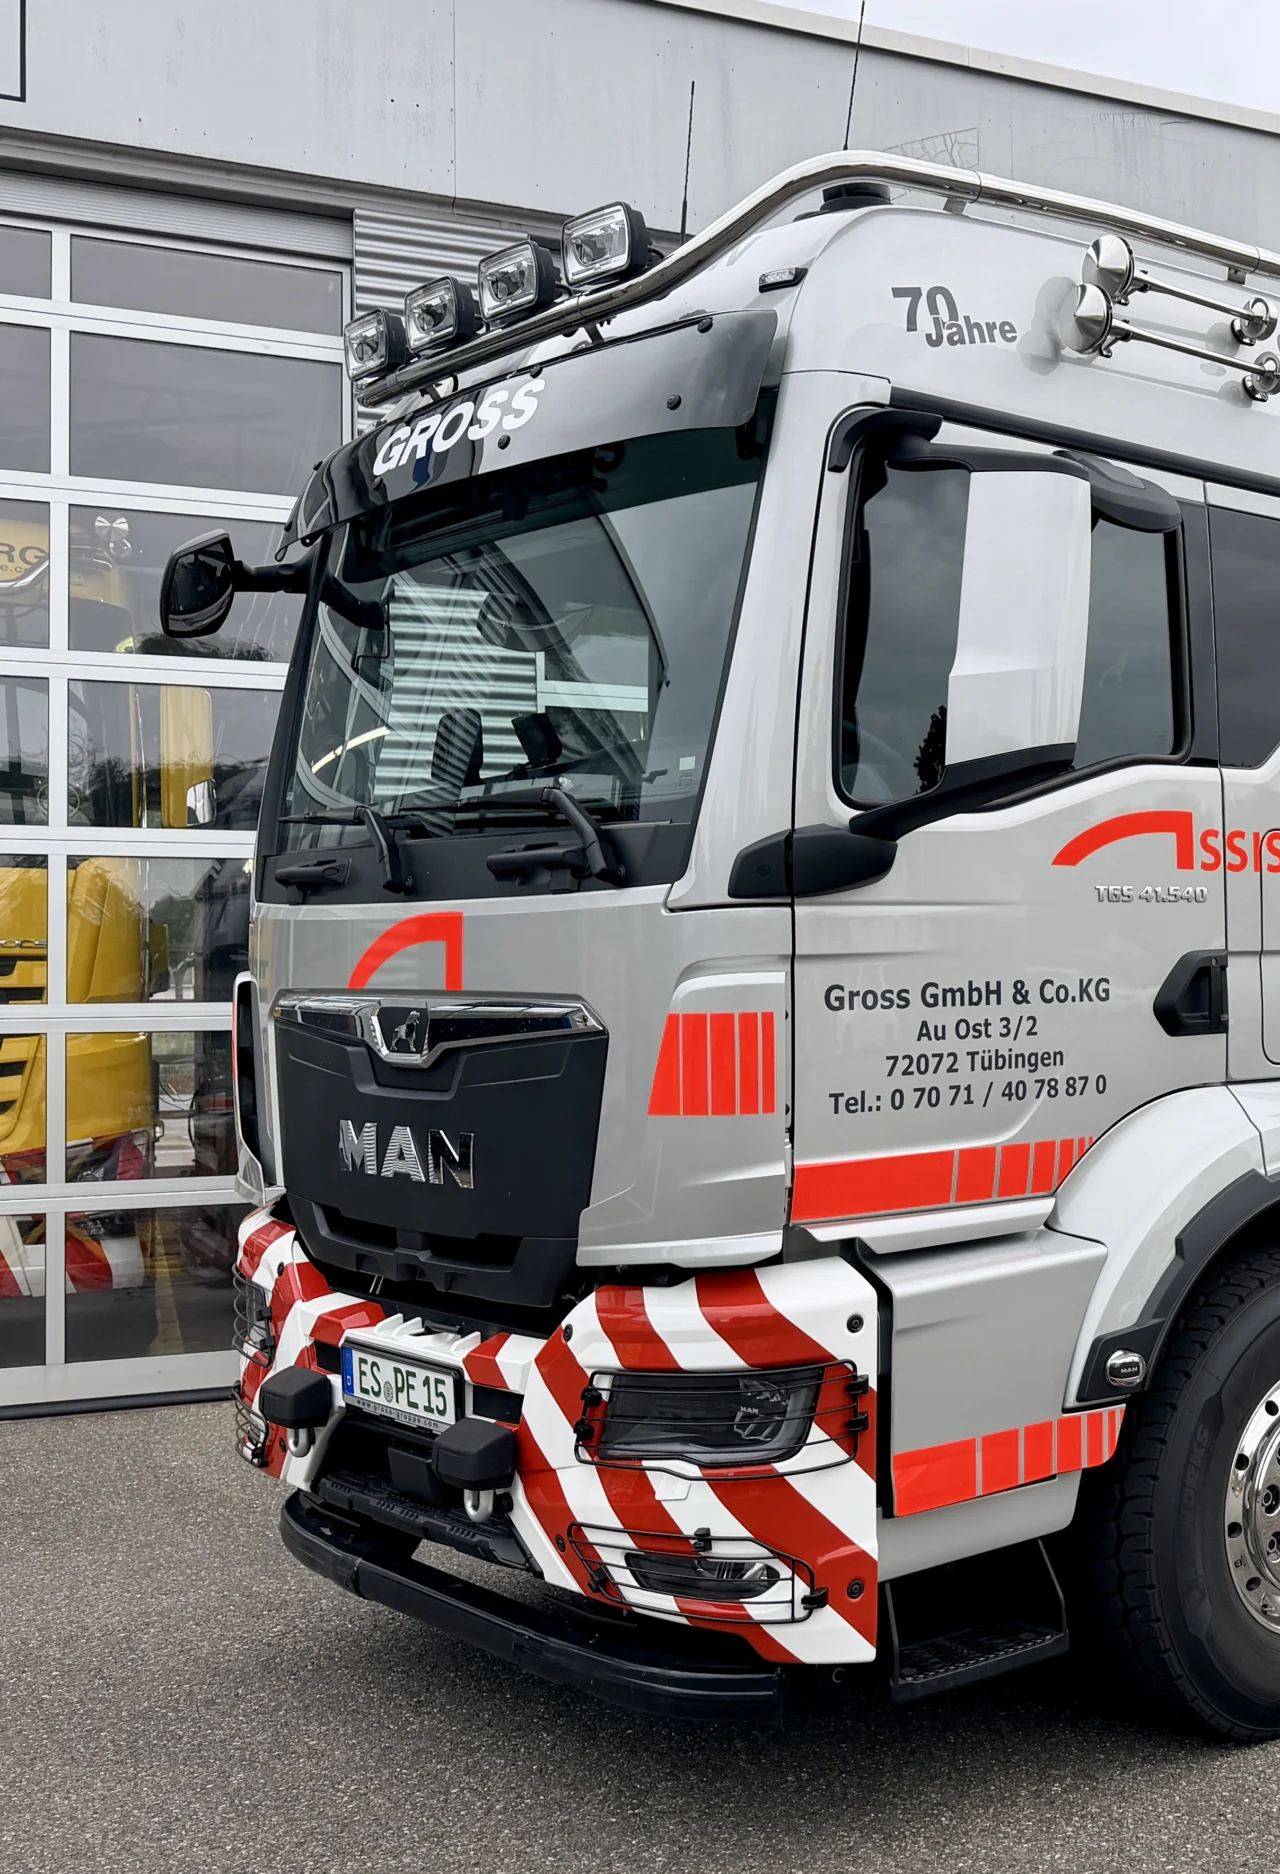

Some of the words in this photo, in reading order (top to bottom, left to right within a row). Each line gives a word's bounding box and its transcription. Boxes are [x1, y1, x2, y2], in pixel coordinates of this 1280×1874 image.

[891, 286, 959, 332] 70
[925, 316, 1017, 347] Jahre
[373, 379, 545, 476] GROSS
[1095, 885, 1134, 903] TGS
[1139, 886, 1208, 904] 41.540
[824, 984, 911, 1012] Gross
[920, 980, 1002, 1008] GmbH
[1012, 979, 1031, 1006] &
[1039, 977, 1110, 1004] Co.KG
[916, 1020, 946, 1042] Au
[955, 1018, 992, 1039] Ost
[999, 1015, 1038, 1041] 3/2
[885, 1052, 959, 1078] 72072
[966, 1048, 1064, 1074] Tübingen
[828, 1090, 882, 1115] Tel.:
[890, 1089, 904, 1111] 0
[913, 1086, 941, 1109] 70
[948, 1083, 974, 1106] 71
[982, 1081, 994, 1107] /
[1001, 1079, 1027, 1102] 40
[1034, 1077, 1059, 1099] 78
[1065, 1075, 1089, 1097] 87
[1095, 1074, 1107, 1095] 0
[338, 1118, 475, 1190] MAN
[346, 1375, 352, 1386] D
[1121, 1366, 1138, 1374] MAN
[358, 1356, 382, 1398] ES
[393, 1366, 419, 1410] PE
[422, 1375, 448, 1417] 15
[356, 1400, 439, 1429] www.gross-gruppe.com
[740, 1405, 759, 1414] MAN
